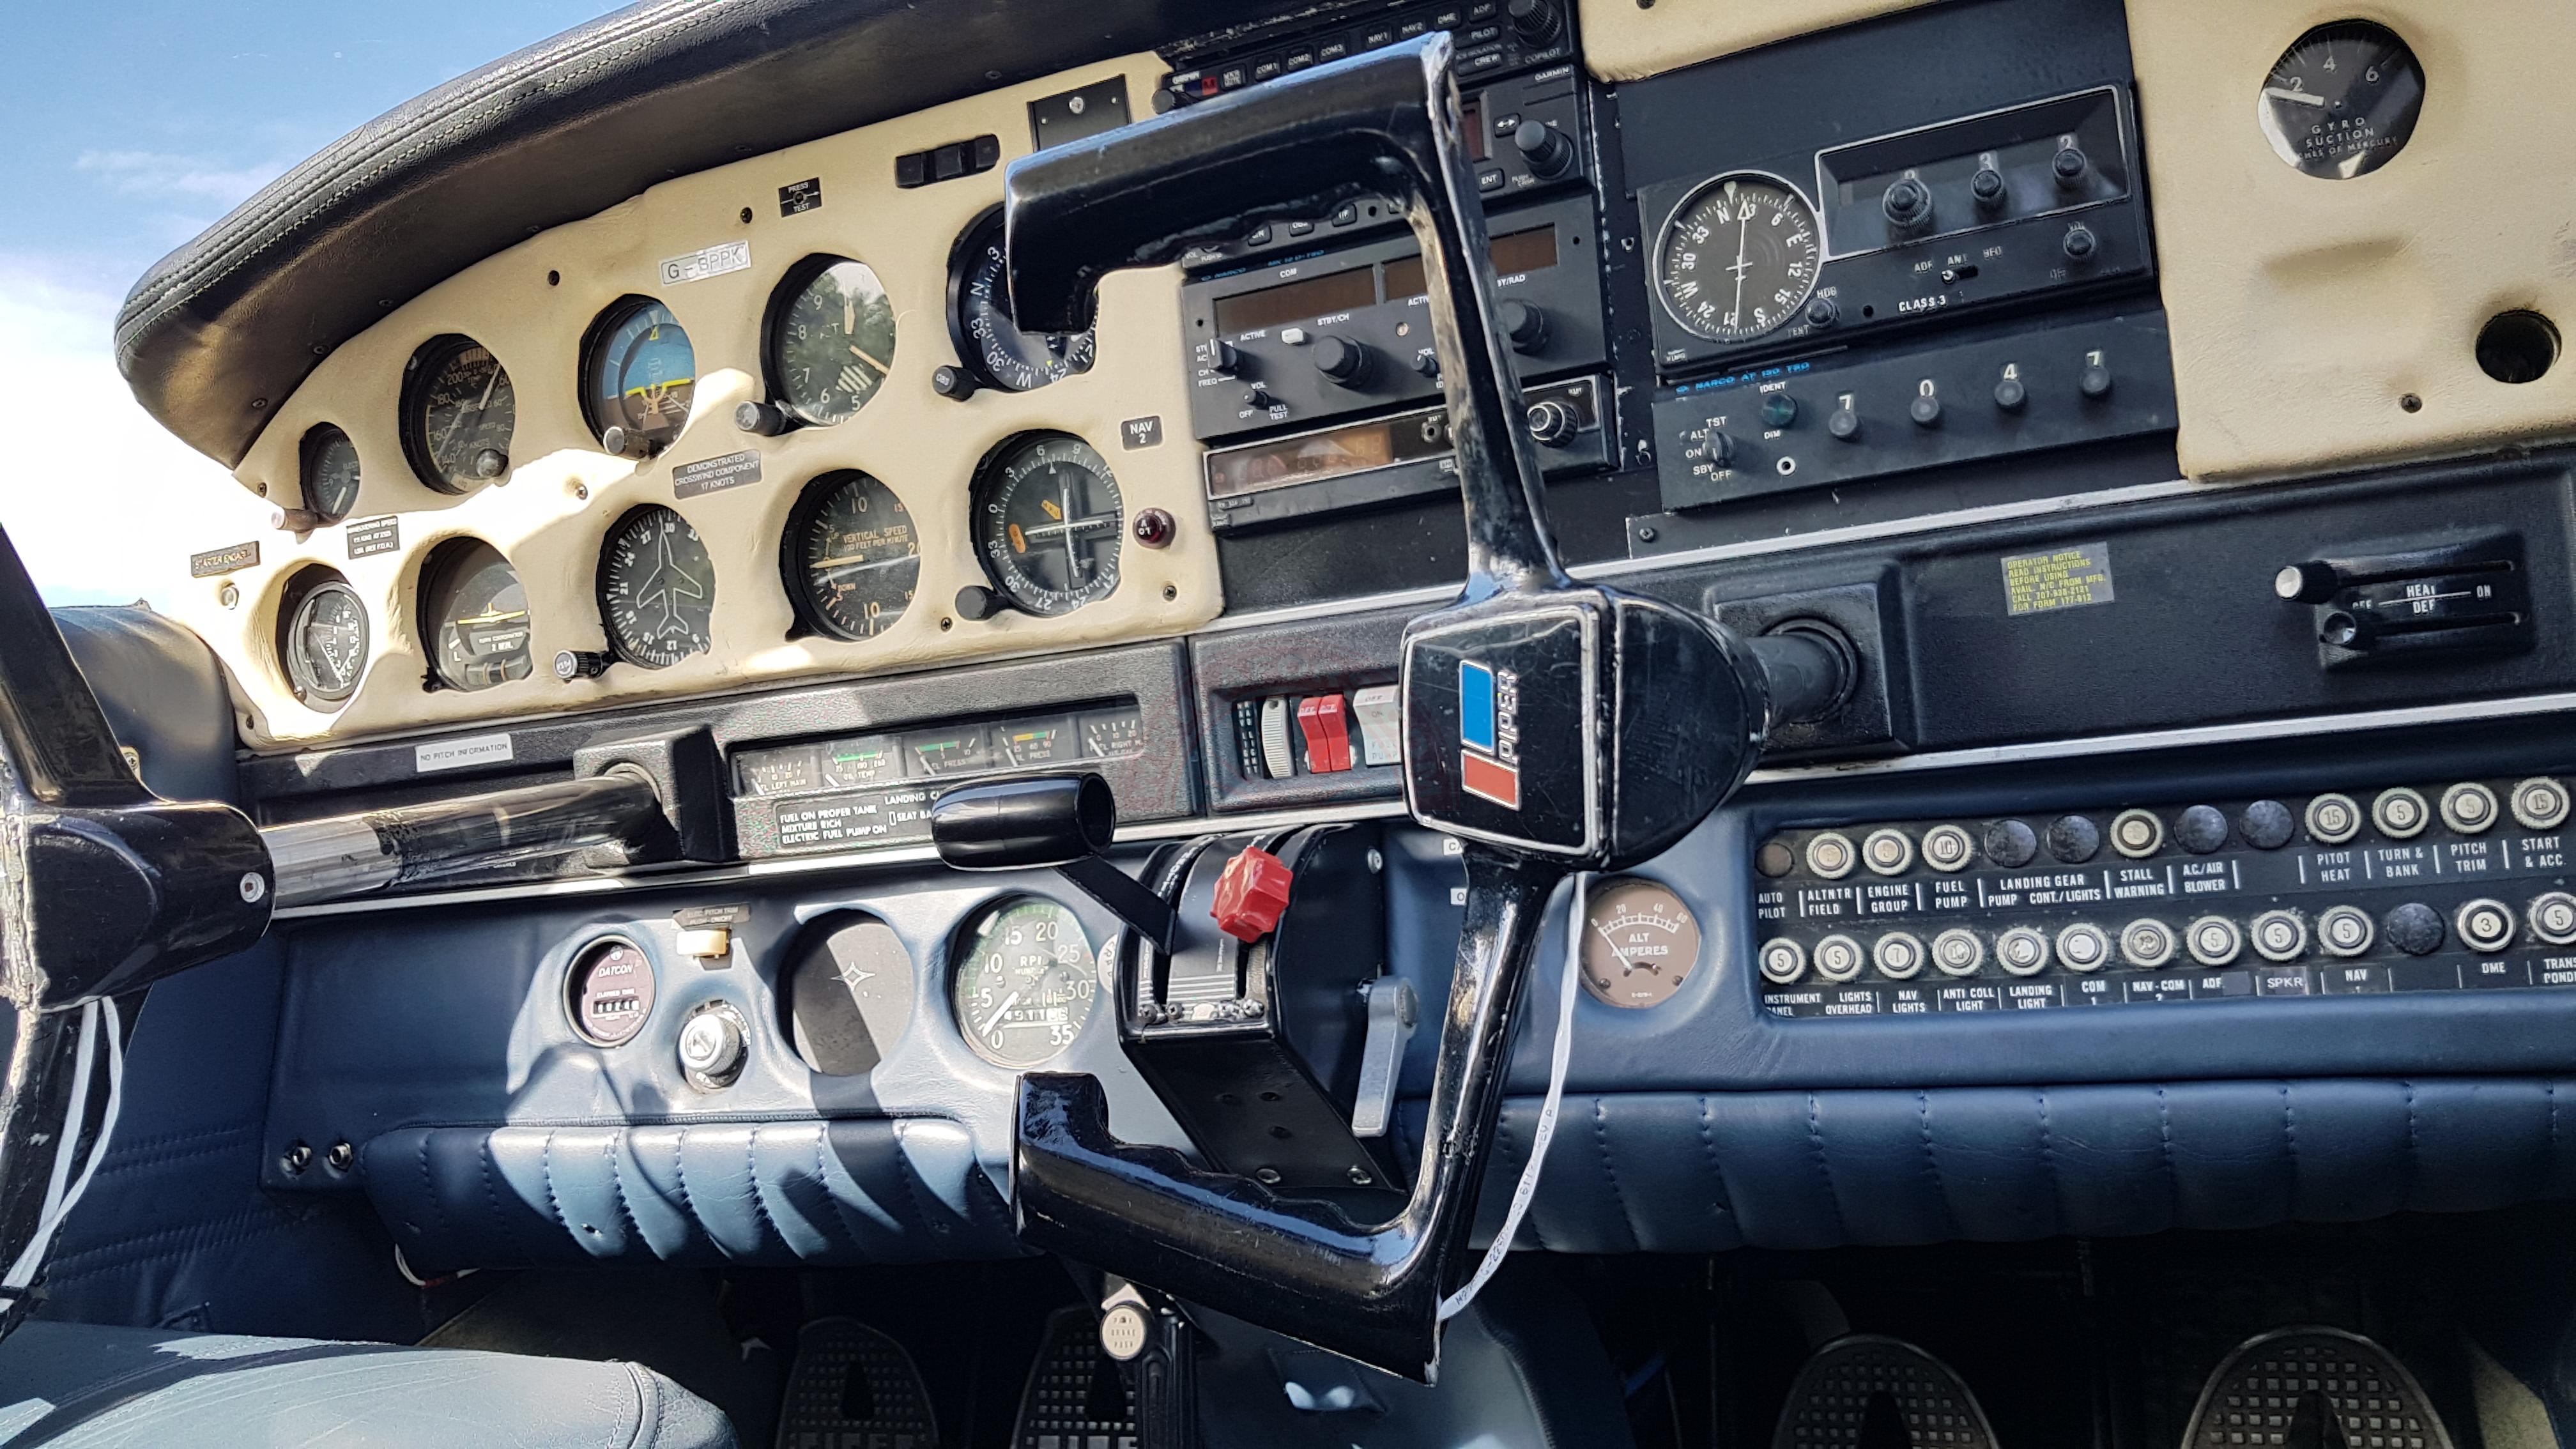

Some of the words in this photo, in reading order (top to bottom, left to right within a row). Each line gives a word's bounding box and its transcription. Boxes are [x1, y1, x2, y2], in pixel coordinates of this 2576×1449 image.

[2324, 56, 2336, 71] 4
[1535, 67, 1570, 81] GARMIN
[2365, 66, 2379, 82] 6
[2290, 77, 2303, 92] 2
[2312, 118, 2365, 134] GYRO
[2306, 128, 2374, 148] SUCTION
[793, 203, 810, 212] TEST
[1716, 207, 1730, 224] N
[1771, 213, 1784, 226] 6
[1786, 234, 1804, 247] E
[988, 246, 999, 260] 3
[1788, 262, 1803, 277] 12
[970, 282, 985, 296] N
[1681, 281, 1699, 299] W
[813, 295, 823, 310] 9
[1898, 296, 1935, 313] CLASS
[1937, 295, 1947, 307] 3
[1754, 308, 1767, 323] S
[798, 324, 806, 340] 8
[970, 318, 986, 339] 33
[1240, 330, 1267, 341] ACTIVE
[986, 351, 1005, 372] 30
[802, 368, 810, 383] 7
[1016, 372, 1032, 388] W
[1696, 376, 1735, 390] NARCO
[1741, 372, 1756, 383] AT
[1839, 395, 1852, 410] 7
[1919, 379, 1935, 397] 0
[2004, 364, 2018, 380] 4
[2087, 351, 2101, 366] 7
[1759, 381, 1786, 394] IDENT
[820, 388, 831, 404] 6
[851, 395, 861, 411] 5
[1130, 421, 1153, 434] NAV
[1706, 415, 1727, 427] TST
[1138, 434, 1146, 444] 2
[1690, 428, 1709, 440] ALT
[1764, 430, 1782, 440] DIM
[1685, 448, 1702, 458] ON
[687, 454, 745, 473] DEMONSTRATED
[1693, 463, 1713, 475] SBY
[675, 470, 714, 486] CROSSWIND
[715, 461, 760, 477] COMPONENT
[1711, 470, 1732, 482] OFF
[710, 477, 735, 489] KNOTS
[851, 496, 868, 515] 10
[664, 523, 675, 533] 30
[843, 530, 879, 544] VERTICAL
[884, 525, 908, 539] SPEED
[2007, 556, 2048, 569] OPERATOR
[2052, 551, 2082, 561] NOTICE
[2009, 569, 2029, 578] READ
[2034, 558, 2091, 574] INSTRUCTIONS
[2010, 574, 2039, 586] BEFORE
[2044, 571, 2069, 581] USING
[2406, 585, 2436, 599] HEAT
[2476, 584, 2492, 598] ON
[864, 602, 880, 619] 10
[2412, 599, 2436, 615] DEF
[453, 651, 461, 662] L
[1497, 668, 1519, 767] PIPER
[420, 753, 432, 762] NO
[433, 751, 455, 760] PITCH
[457, 742, 508, 757] INFORMATION
[885, 792, 926, 805] LANDING
[801, 811, 816, 821] ON
[818, 808, 851, 818] PROPER
[853, 804, 878, 815] TANK
[2396, 804, 2405, 820] 5
[781, 822, 817, 834] MIXTURE
[820, 819, 842, 829] RICH
[782, 833, 819, 845] ELECTRIC
[846, 826, 871, 838] PUMP
[872, 825, 887, 834] ON
[2450, 842, 2487, 855] PITCH
[2522, 836, 2561, 851] START
[2317, 851, 2351, 865] PITOT
[2378, 848, 2411, 861] TURN
[2415, 847, 2423, 859] &
[2455, 859, 2487, 872] TRIM
[2525, 855, 2534, 868] &
[2120, 868, 2154, 881] STALL
[2321, 868, 2351, 882] HEAT
[2386, 864, 2419, 878] BANK
[1935, 880, 1965, 893] FUEL
[2000, 877, 2051, 891] LANDING
[2055, 874, 2085, 887] GEAR
[2184, 878, 2226, 893] BLOWER
[1758, 892, 1782, 904] AUTO
[1807, 887, 1851, 902] ALTNTR
[1867, 884, 1909, 898] ENGINE
[2114, 884, 2165, 898] WARNING
[1871, 900, 1908, 914] GROUP
[1935, 896, 1968, 908] PUMP
[1988, 894, 2017, 907] PUMP
[1616, 903, 1627, 914] 20
[1758, 906, 1786, 919] PILOT
[1809, 903, 1841, 916] FIELD
[1591, 918, 1598, 926] 0
[2481, 917, 2492, 932] 3
[2554, 910, 2564, 926] 5
[1005, 926, 1022, 946] 15
[1036, 921, 1059, 942] 20
[1629, 932, 1650, 943] ALT
[2274, 928, 2282, 944] 5
[2343, 923, 2351, 939] 5
[2211, 932, 2218, 948] 5
[1057, 944, 1081, 963] 25
[1611, 945, 1669, 958] AMPERES
[1834, 950, 1841, 965] 5
[985, 953, 1003, 974] 10
[1777, 952, 1785, 967] 5
[599, 965, 634, 977] DATCON
[2481, 961, 2506, 974] DME
[2345, 969, 2368, 981] NAV
[2082, 979, 2106, 993] COM
[2202, 977, 2222, 989] ADF
[2267, 977, 2304, 988] SPKR
[1066, 980, 1090, 1000] 30
[1839, 991, 1872, 1002] LIGHTS
[1898, 990, 1917, 1000] NAV
[1943, 988, 1966, 999] ANTI
[1970, 987, 1995, 998] COLL
[2009, 985, 2052, 997] LANDING
[981, 988, 993, 1008] 5
[1765, 992, 1821, 1004] INSTRUMENT
[2018, 998, 2046, 1009] LIGHT
[1825, 1004, 1873, 1015] OVERHEAD
[1892, 1002, 1926, 1013] LIGHTS
[1955, 1000, 1984, 1011] LIGHT
[991, 1031, 1004, 1049] 0
[1050, 1024, 1075, 1046] 35
